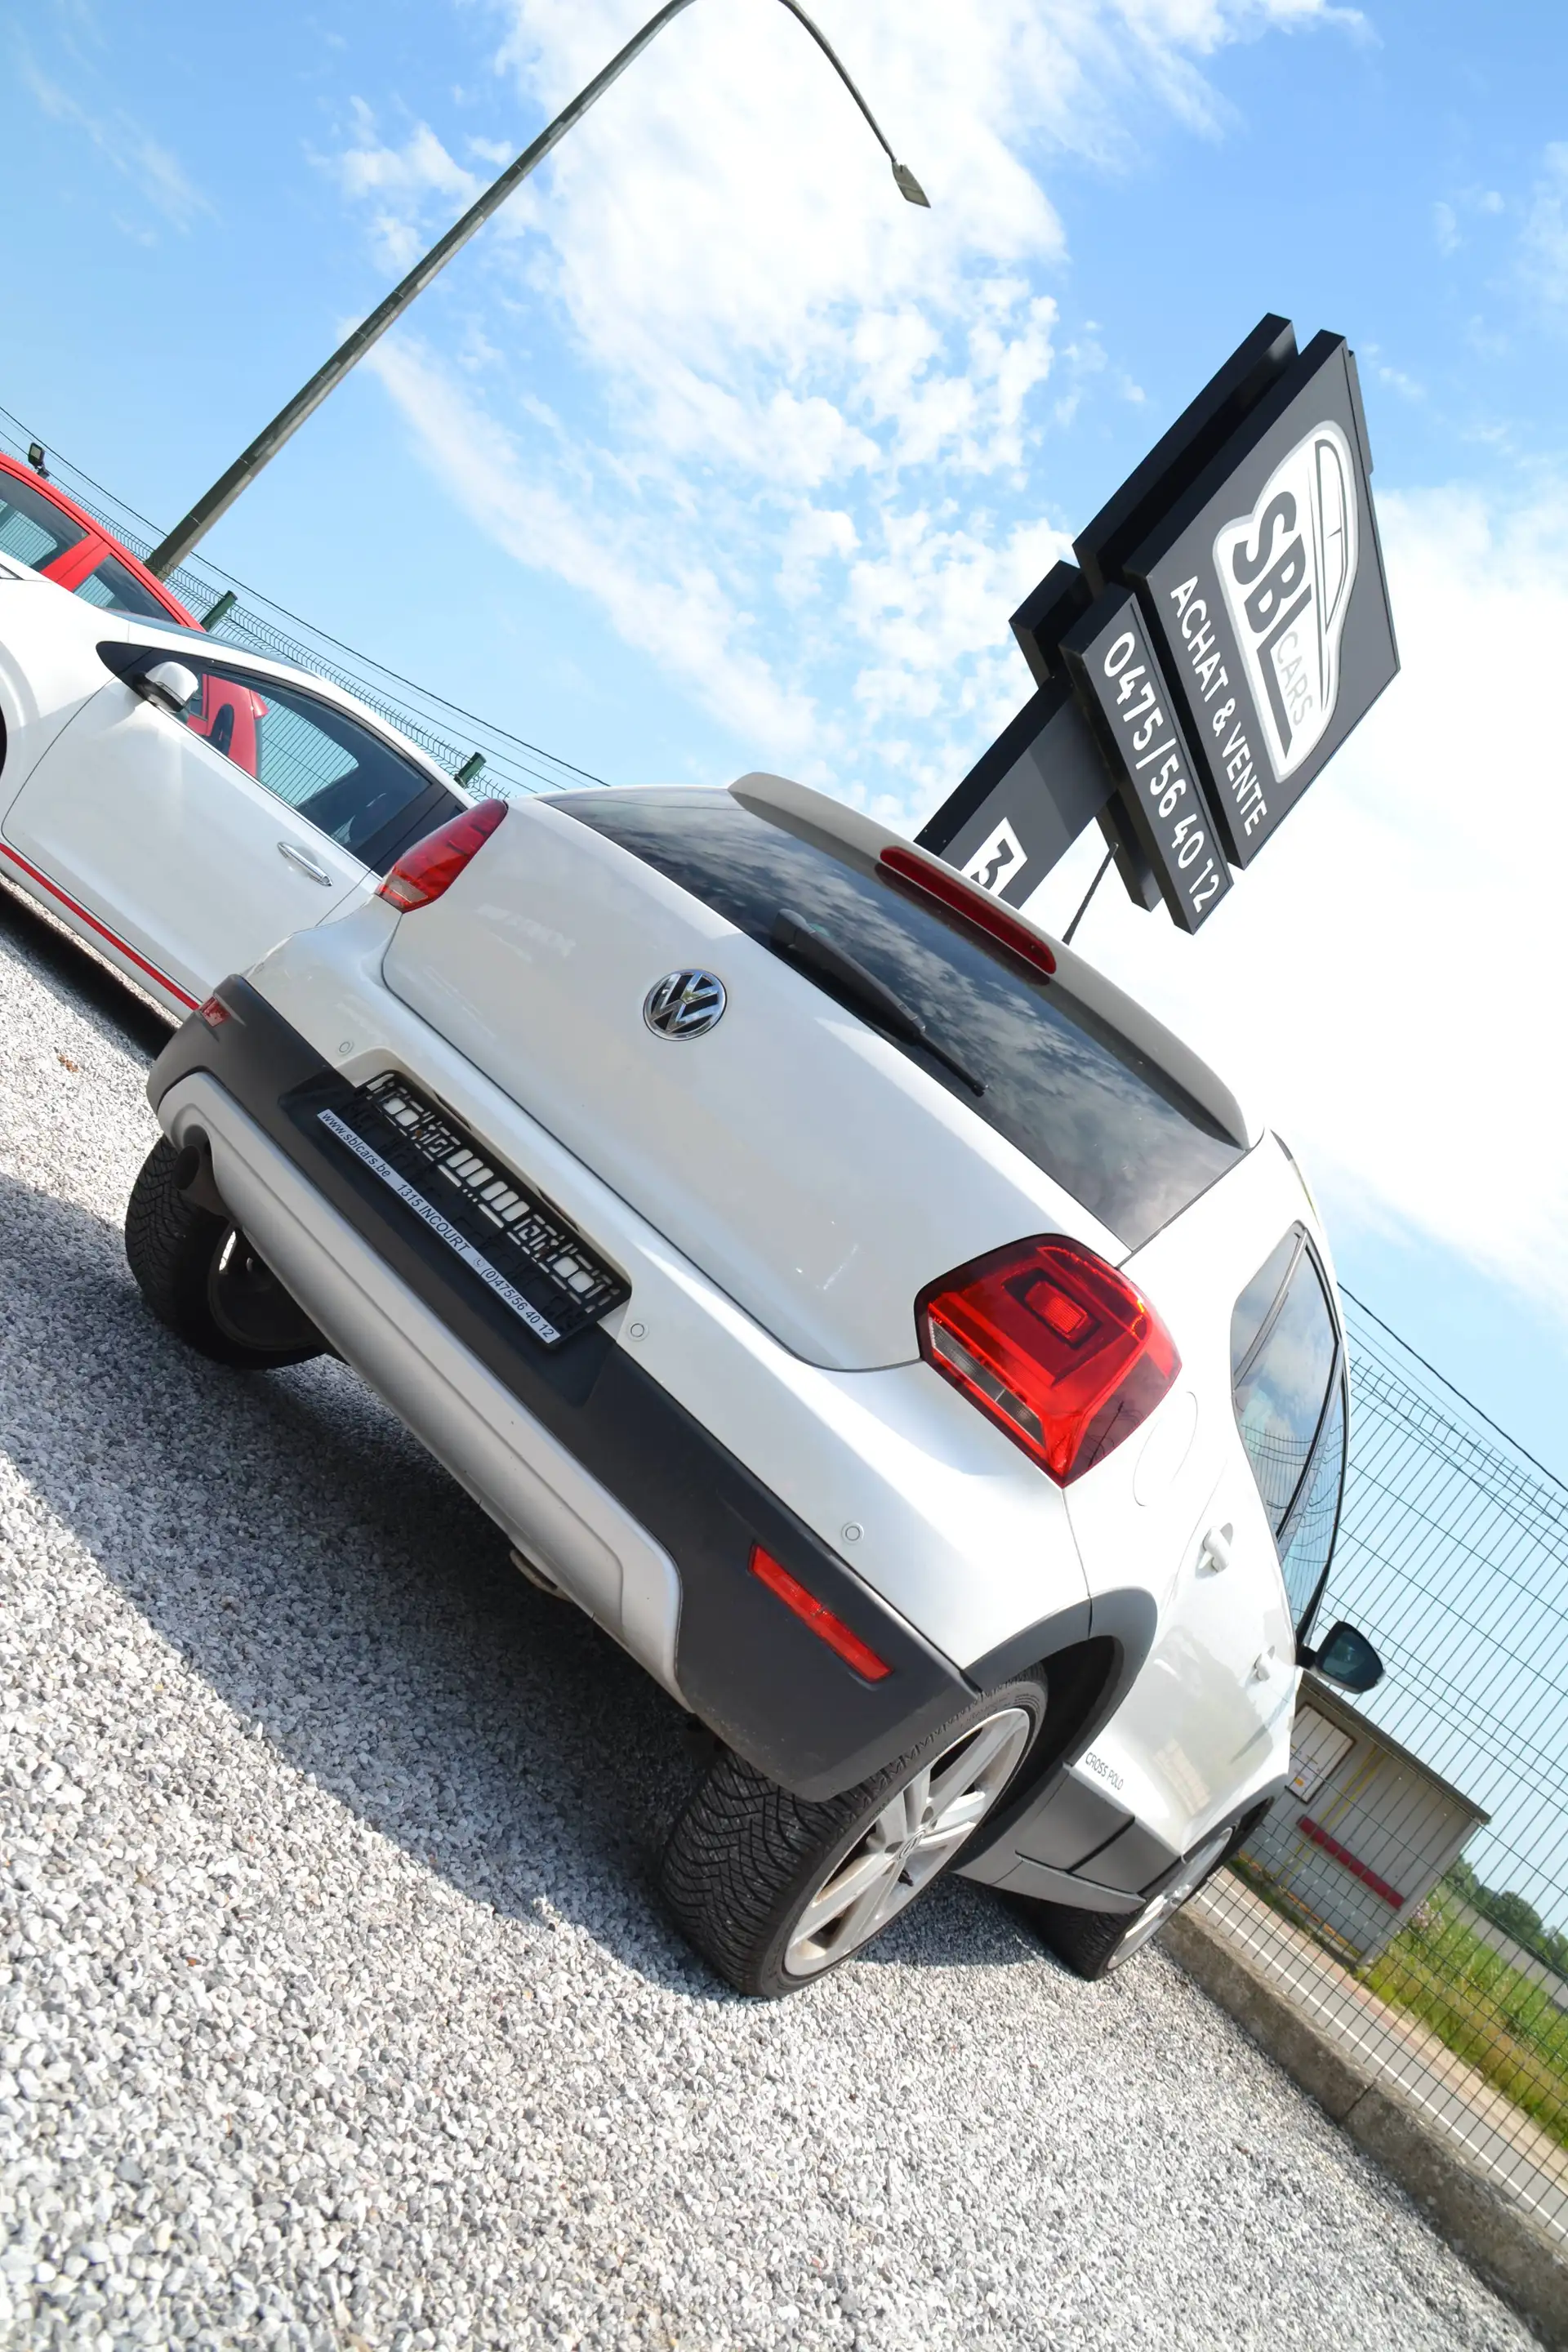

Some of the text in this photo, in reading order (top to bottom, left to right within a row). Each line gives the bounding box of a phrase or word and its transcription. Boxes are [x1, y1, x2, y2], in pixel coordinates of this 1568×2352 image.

[1170, 576, 1267, 836] ACHAT & VENTE
[1232, 491, 1312, 760] SBL
[1276, 630, 1313, 726] CARS
[1104, 631, 1219, 913] 0475/56 40 12
[322, 1113, 555, 1338] www.sblcars.be 1315 INCOURT (0)475/56 40 12
[1085, 1752, 1124, 1790] CROSS POLO
